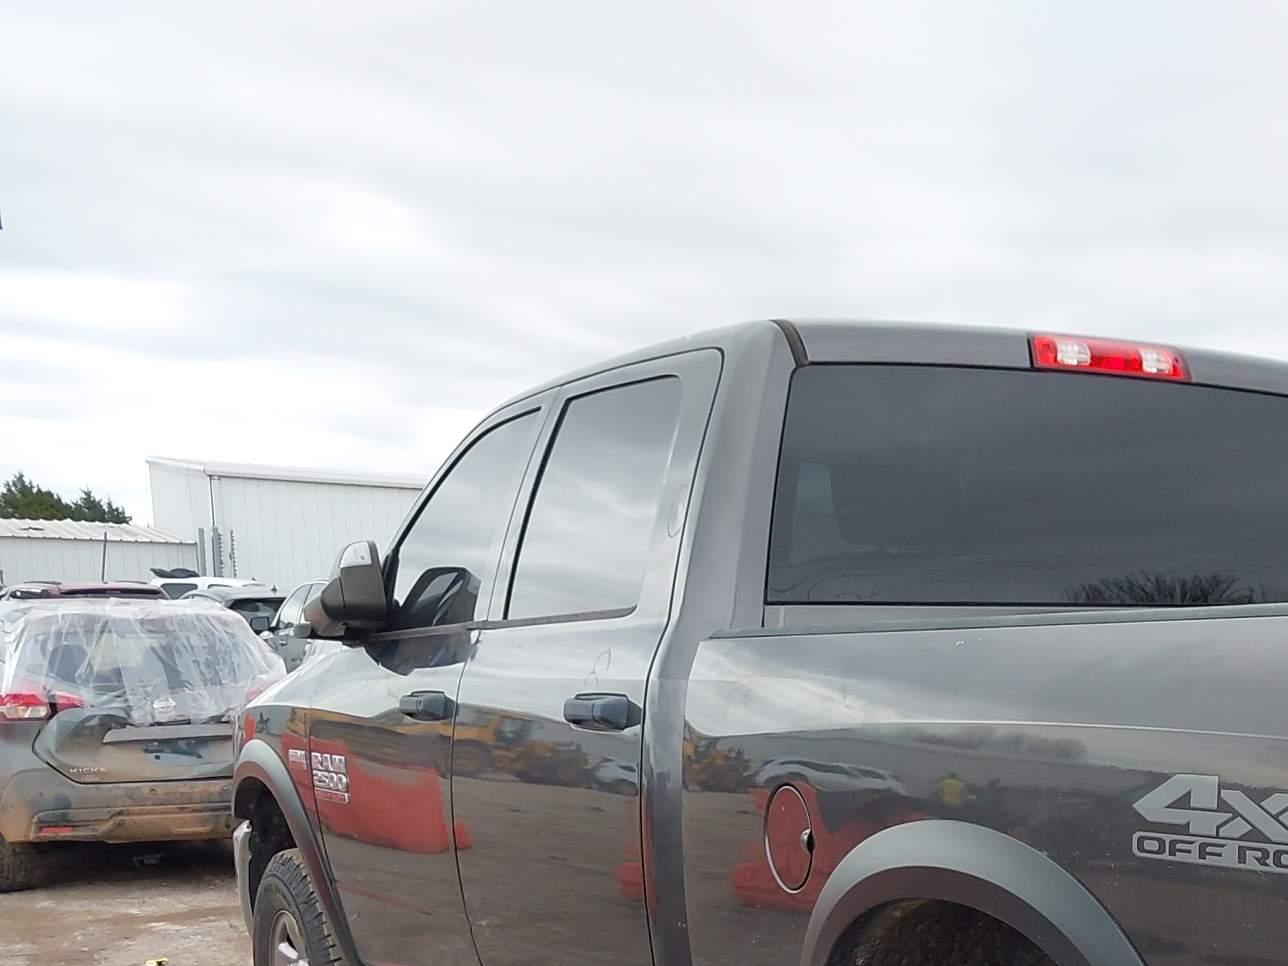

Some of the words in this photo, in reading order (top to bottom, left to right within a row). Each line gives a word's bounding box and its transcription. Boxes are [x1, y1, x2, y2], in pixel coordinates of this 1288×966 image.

[311, 752, 346, 773] RAM
[313, 769, 348, 792] 2500
[1136, 835, 1227, 860] OFF
